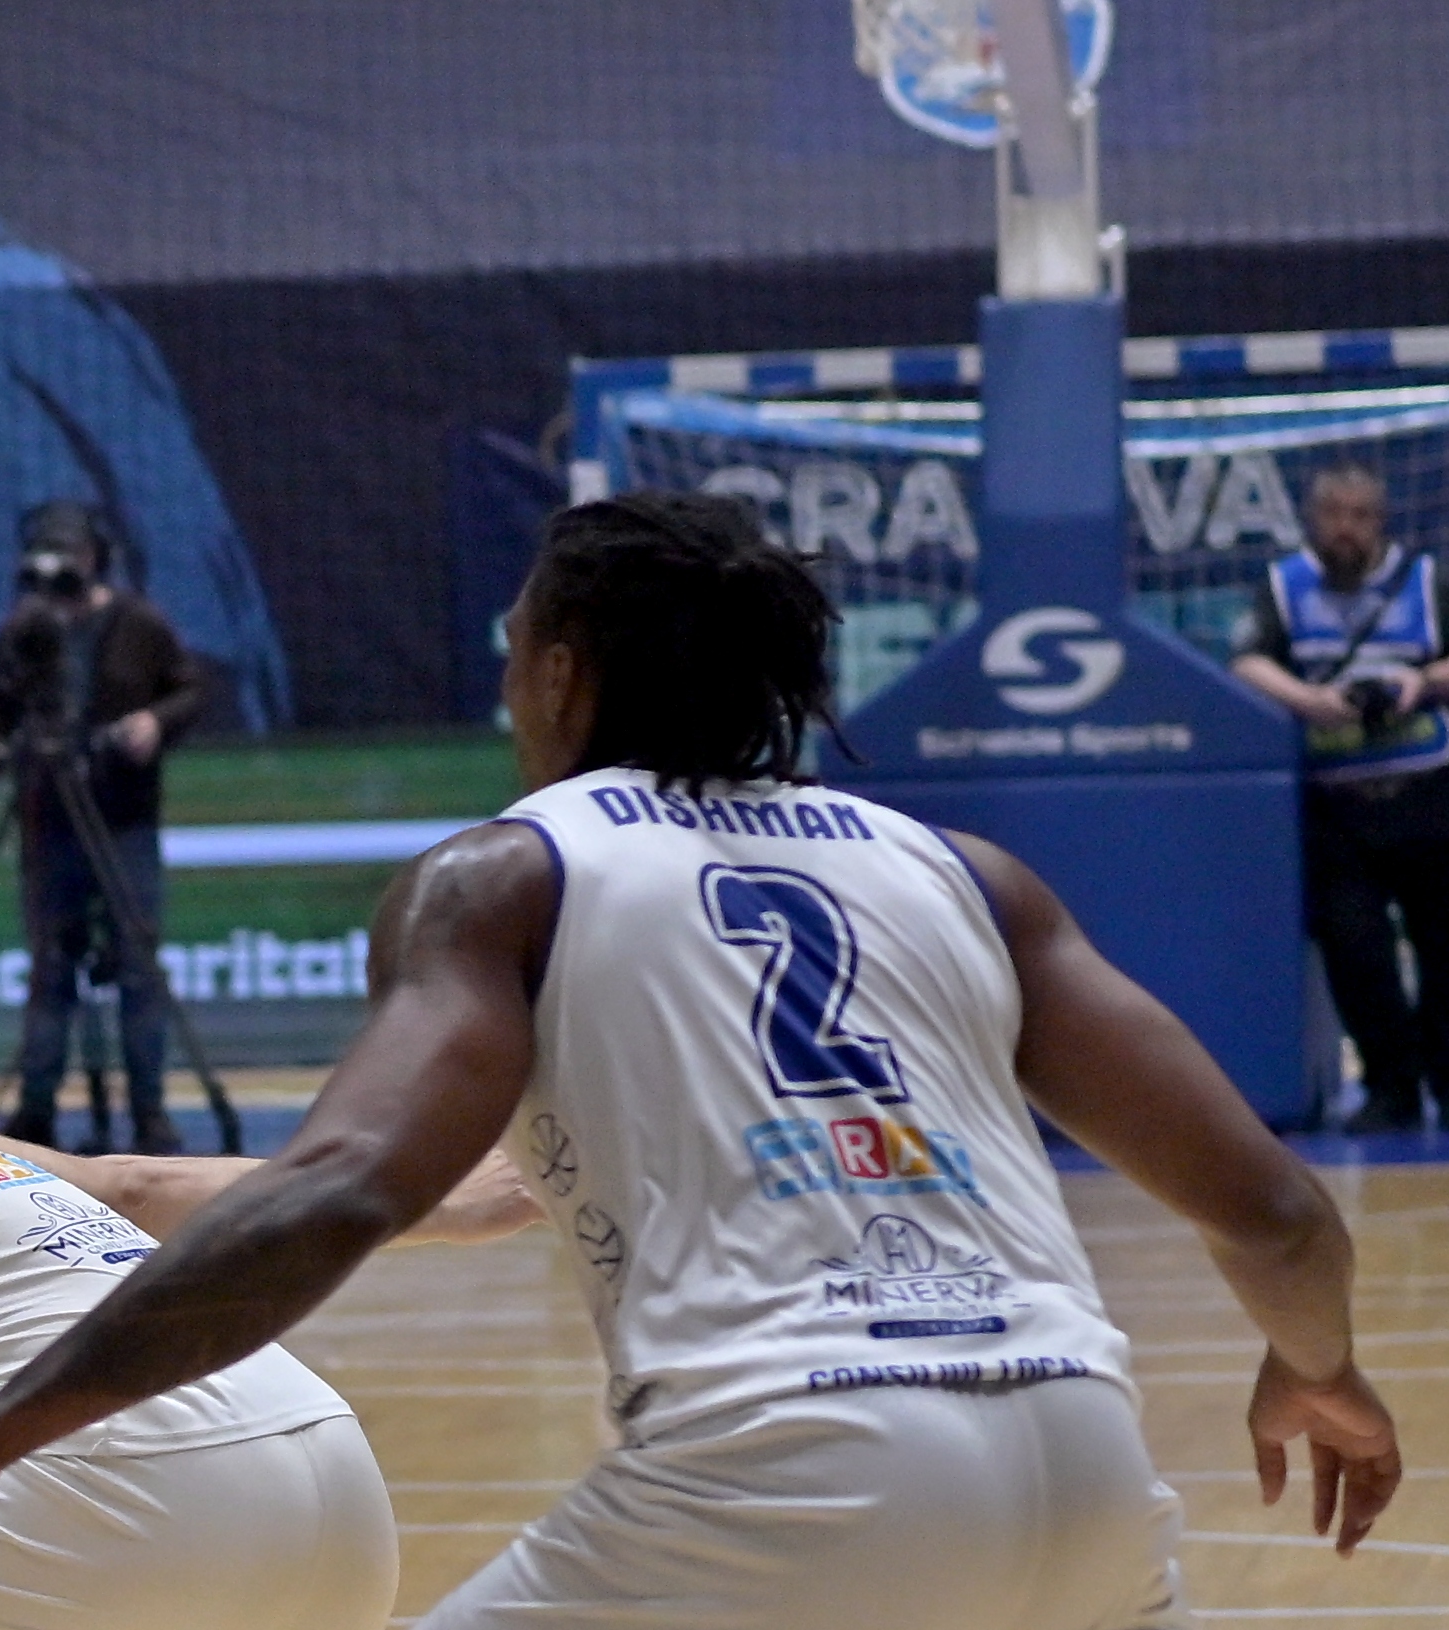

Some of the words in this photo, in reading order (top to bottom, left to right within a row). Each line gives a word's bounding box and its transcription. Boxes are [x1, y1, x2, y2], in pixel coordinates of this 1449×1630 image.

[589, 785, 875, 841] DISHMAN
[699, 861, 910, 1104] 2
[43, 1219, 140, 1261] MINERVA
